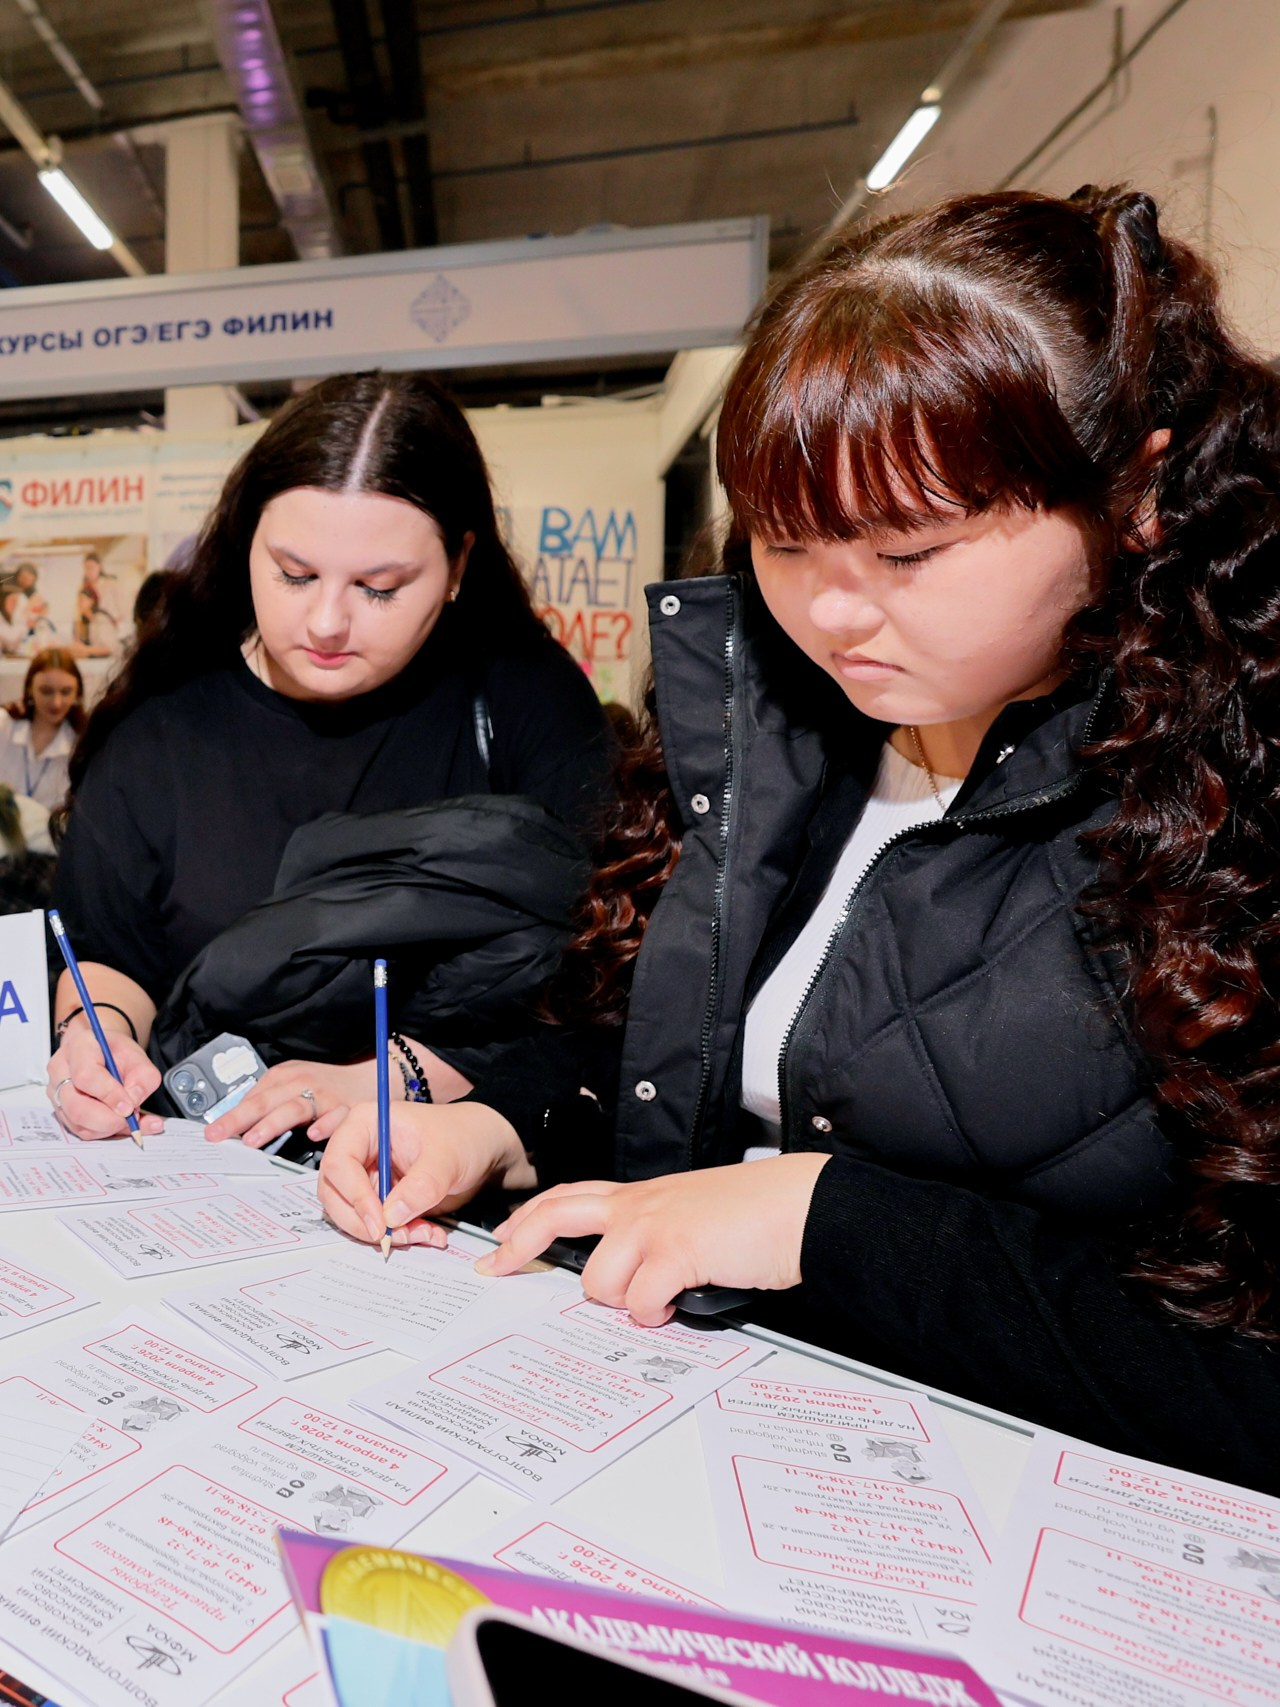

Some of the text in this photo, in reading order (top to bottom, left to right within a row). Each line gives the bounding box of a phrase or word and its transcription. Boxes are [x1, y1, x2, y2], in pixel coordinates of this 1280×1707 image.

[222, 308, 334, 336] ФИЛИН
[21, 475, 144, 508] ФИЛИН
[539, 507, 637, 561] ВАМ
[529, 554, 635, 608] АТАЕТ
[141, 1338, 175, 1355] 12:00
[188, 1301, 291, 1366] ВОЛГОГРАДСКИЙ ФИЛИАЛ
[291, 1330, 323, 1351] МФЮА
[135, 1347, 166, 1363] 2026
[163, 1359, 208, 1382] апреля
[179, 1356, 226, 1379] начало
[97, 1342, 220, 1403] НА ДЕНЬ ОТКРЫТЫХ ДВЕРЕЙ
[117, 1360, 179, 1392] ПРИГЛАШАЕМ
[749, 1380, 874, 1406] начало в 12:00
[761, 1390, 801, 1404] 2026
[802, 1395, 868, 1414] апреля
[405, 1399, 479, 1436] МОСКОВСКИЙ
[726, 1395, 916, 1431] НА ДЕНЬ ОТКРЫТЫХ ДВЕРЕЙ
[775, 1409, 869, 1431] ПРИГЛАШАЕМ
[870, 1407, 883, 1416] 4
[297, 1422, 334, 1442] 2026
[301, 1411, 409, 1461] начало в 12:00
[383, 1399, 547, 1482] ВОЛГОГРАДСКИЙ ФИЛИАЛ
[515, 1429, 569, 1455] МФЮА
[254, 1418, 412, 1493] НА ДЕНЬ ОТКРЫТЫХ ДВЕРЕЙ
[283, 1440, 362, 1480] ПРИГЛАШАЕМ
[333, 1436, 390, 1465] апреля
[386, 1461, 401, 1471] 4
[771, 1442, 828, 1459] studmfua
[227, 1464, 276, 1490] studmfua
[782, 1465, 906, 1495] 8-917-338-96-11
[1108, 1466, 1271, 1520] начало 12:00
[815, 1481, 944, 1513] (8442) 62-10-09
[1068, 1474, 1232, 1530] ОТКРЫТЫХ ДВЕРЕЙ
[1119, 1479, 1257, 1526] апреля 2026
[210, 1503, 268, 1537] 62-10-09
[792, 1503, 925, 1537] 8-917-338-86-48
[1127, 1497, 1247, 1542] ПРИГЛАШАЕМ
[154, 1513, 255, 1573] 8-917-338-86-48
[828, 1521, 965, 1556] (8442) 49-71-32
[1102, 1526, 1173, 1556] studmfua
[164, 1535, 270, 1599] (8442) 49-71-32
[514, 1551, 569, 1581] ДВЕРЕЙ
[569, 1559, 613, 1584] 2026
[573, 1545, 619, 1570] 12:00
[624, 1569, 638, 1578] в
[780, 1541, 975, 1589] приемной комиссии
[46, 1561, 127, 1615] УНИВЕРСИТЕТ
[89, 1537, 229, 1625] приемной комиссии
[106, 1563, 181, 1612] Телефоны
[784, 1575, 901, 1607] УНИВЕРСИТЕТ
[828, 1560, 930, 1590] Телефоны
[28, 1565, 116, 1624] ЮРИДИЧЕСКИЙ
[777, 1582, 904, 1617] ЮРИДИЧЕСКИЙ
[14, 1584, 94, 1640] МОСКОВСКИЙ
[792, 1604, 912, 1637] МОСКОВСКИЙ
[934, 1606, 975, 1623] ЮА
[140, 1622, 200, 1663] МФЮА
[530, 1605, 819, 1679] АКАДЕМИЧЕСКИЙ
[817, 1654, 982, 1707] КОЛЛЕДЖ
[37, 1621, 162, 1707] ВОЛГОГРАДСКИЙ
